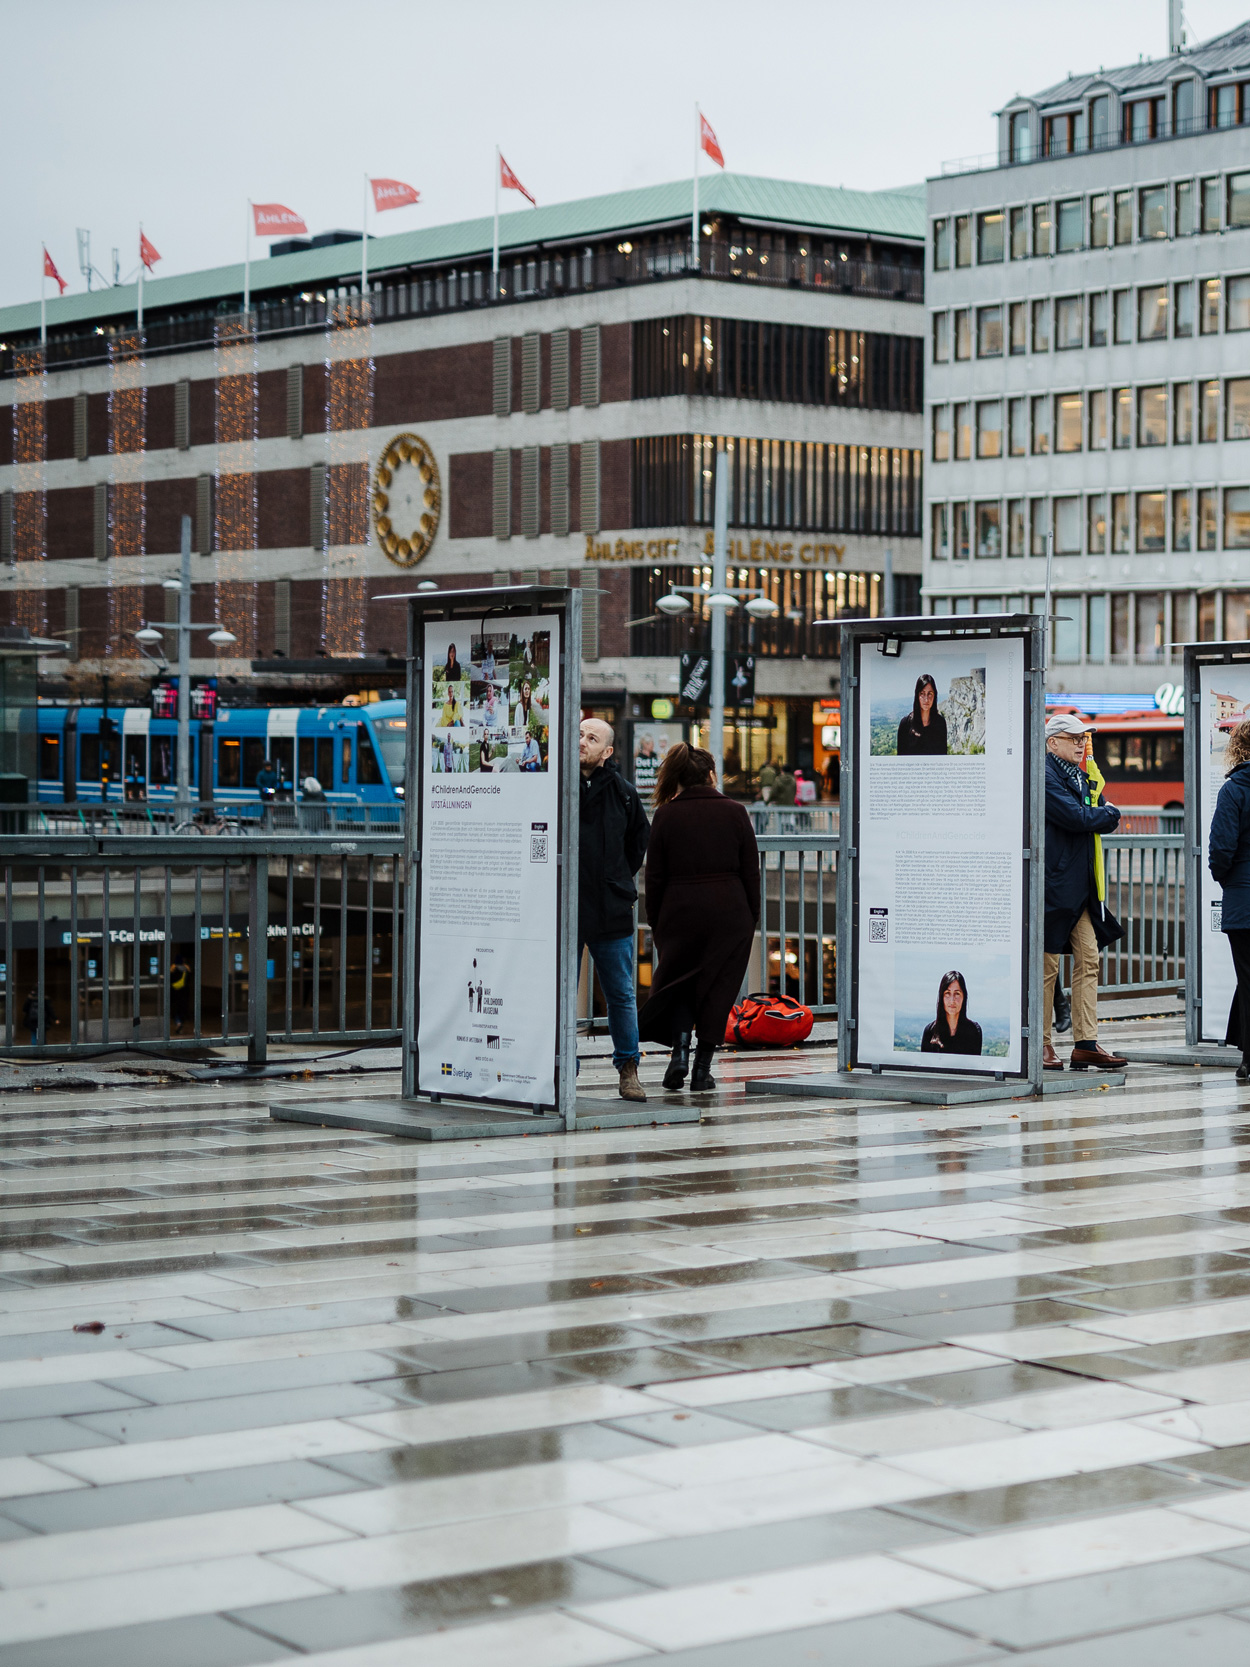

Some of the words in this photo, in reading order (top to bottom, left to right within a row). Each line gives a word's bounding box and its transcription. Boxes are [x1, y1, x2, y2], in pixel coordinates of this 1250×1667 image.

[584, 534, 644, 561] ÅHLÉNS
[799, 543, 847, 564] CITY
[431, 785, 501, 794] #ChildrenAndGenocide
[431, 799, 472, 809] UTSTÄLLNINGEN
[896, 831, 986, 841] #ChildrenAndGenocide
[453, 1068, 472, 1080] Sverige
